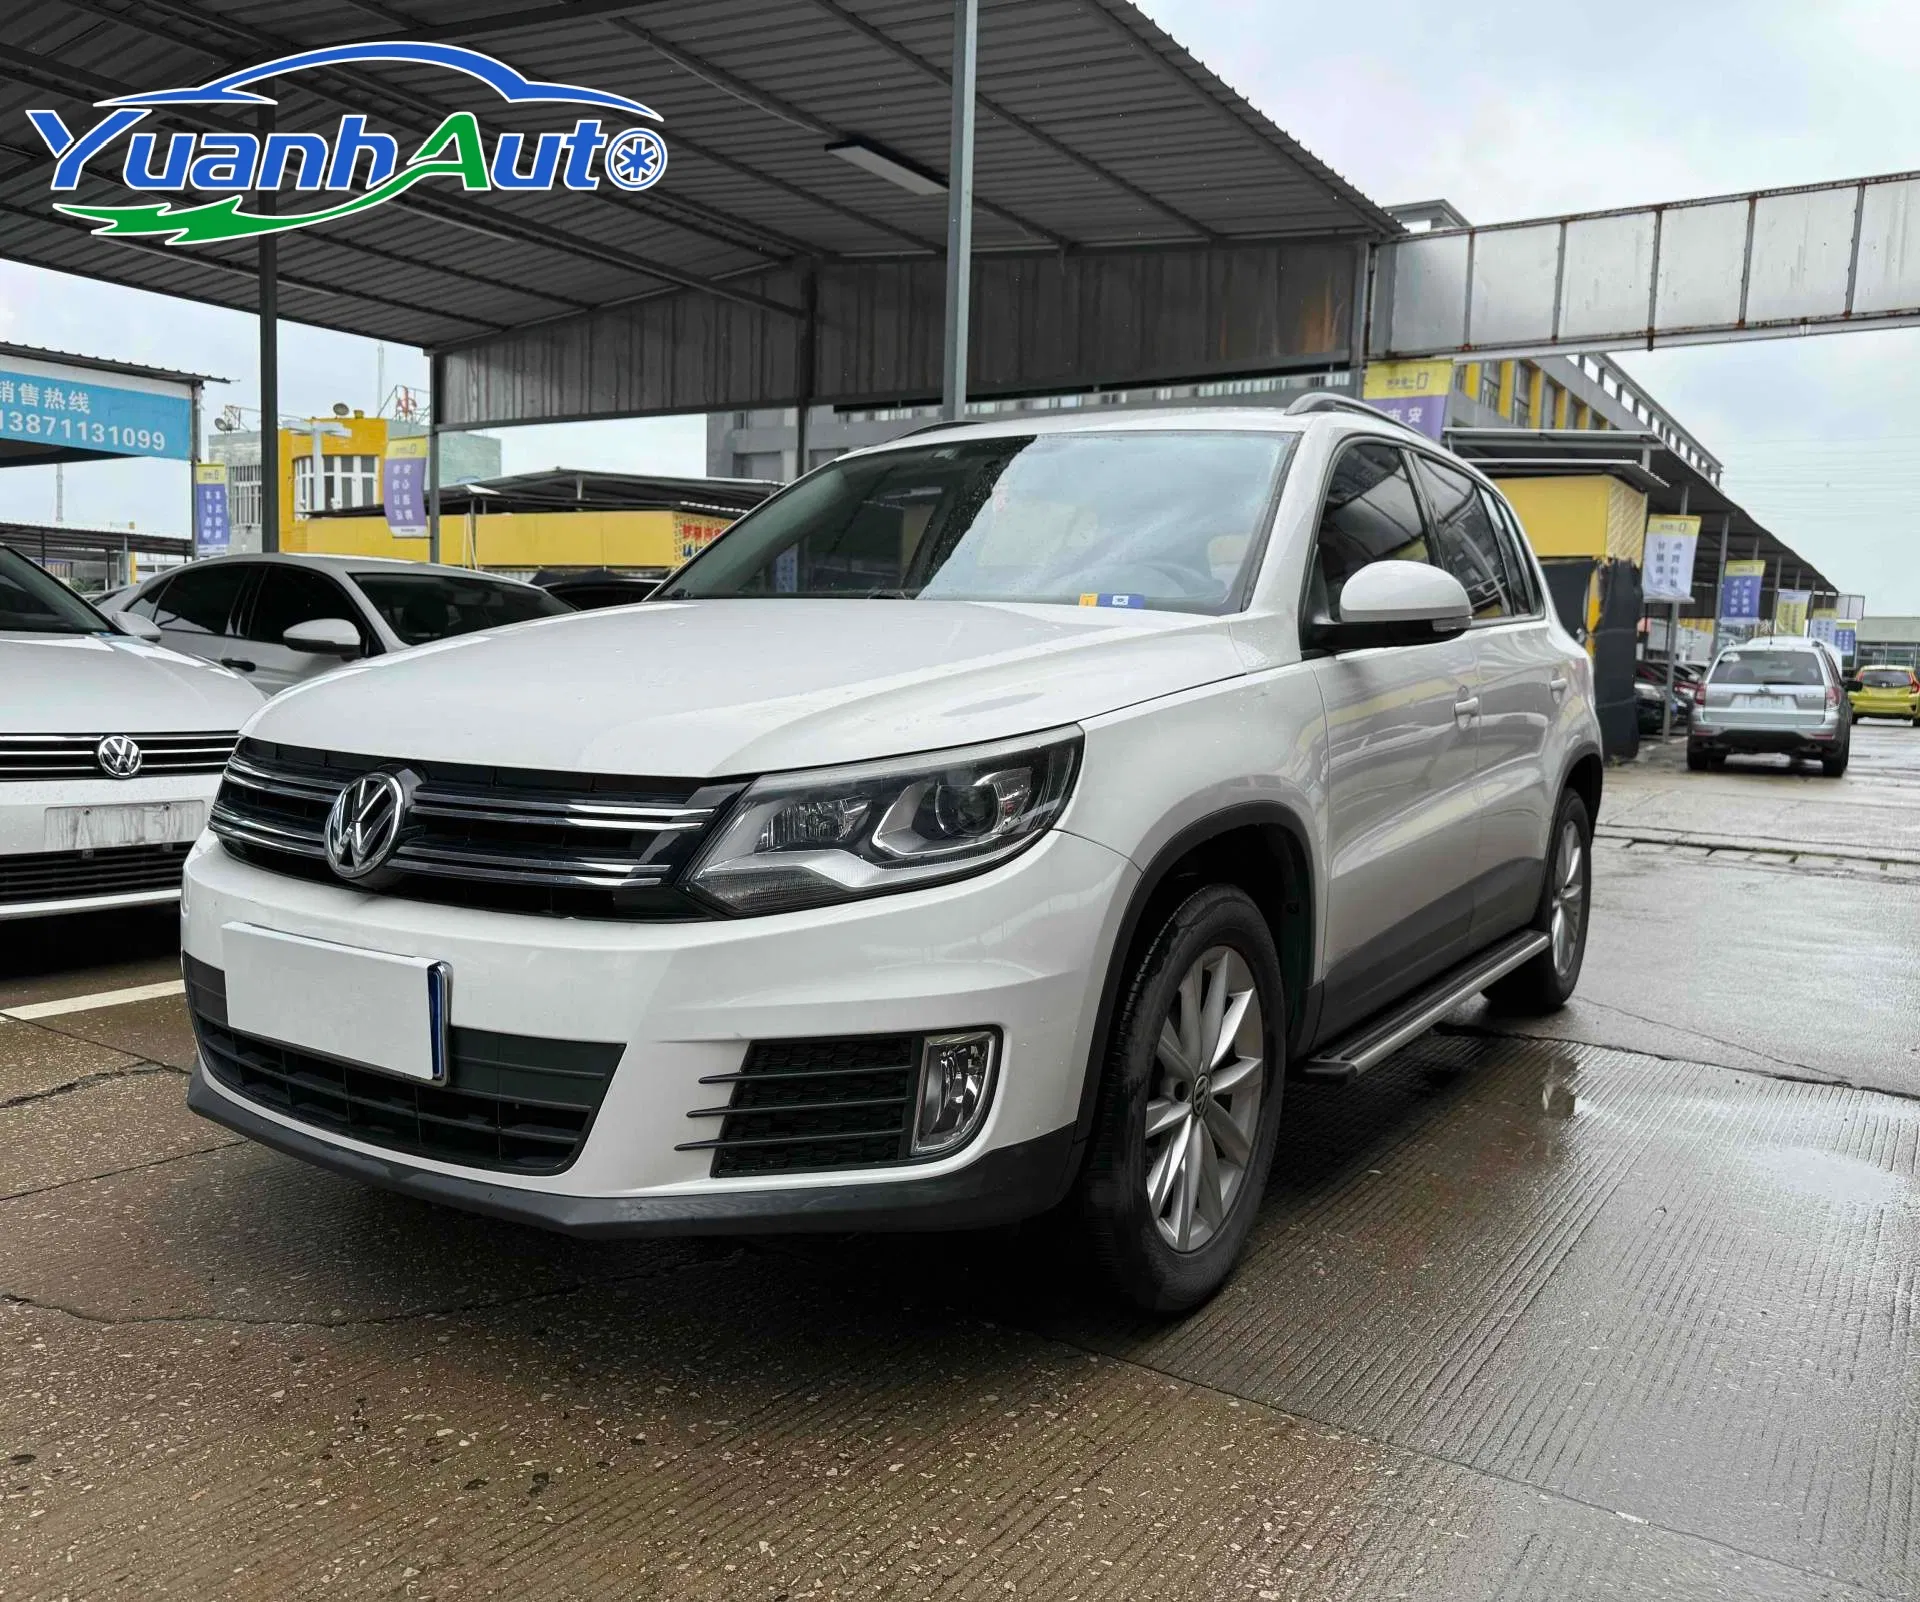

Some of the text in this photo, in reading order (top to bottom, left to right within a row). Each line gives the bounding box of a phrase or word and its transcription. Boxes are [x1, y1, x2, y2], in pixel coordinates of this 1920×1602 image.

[0, 380, 91, 415] 销售热线
[0, 409, 166, 451] 13871131099
